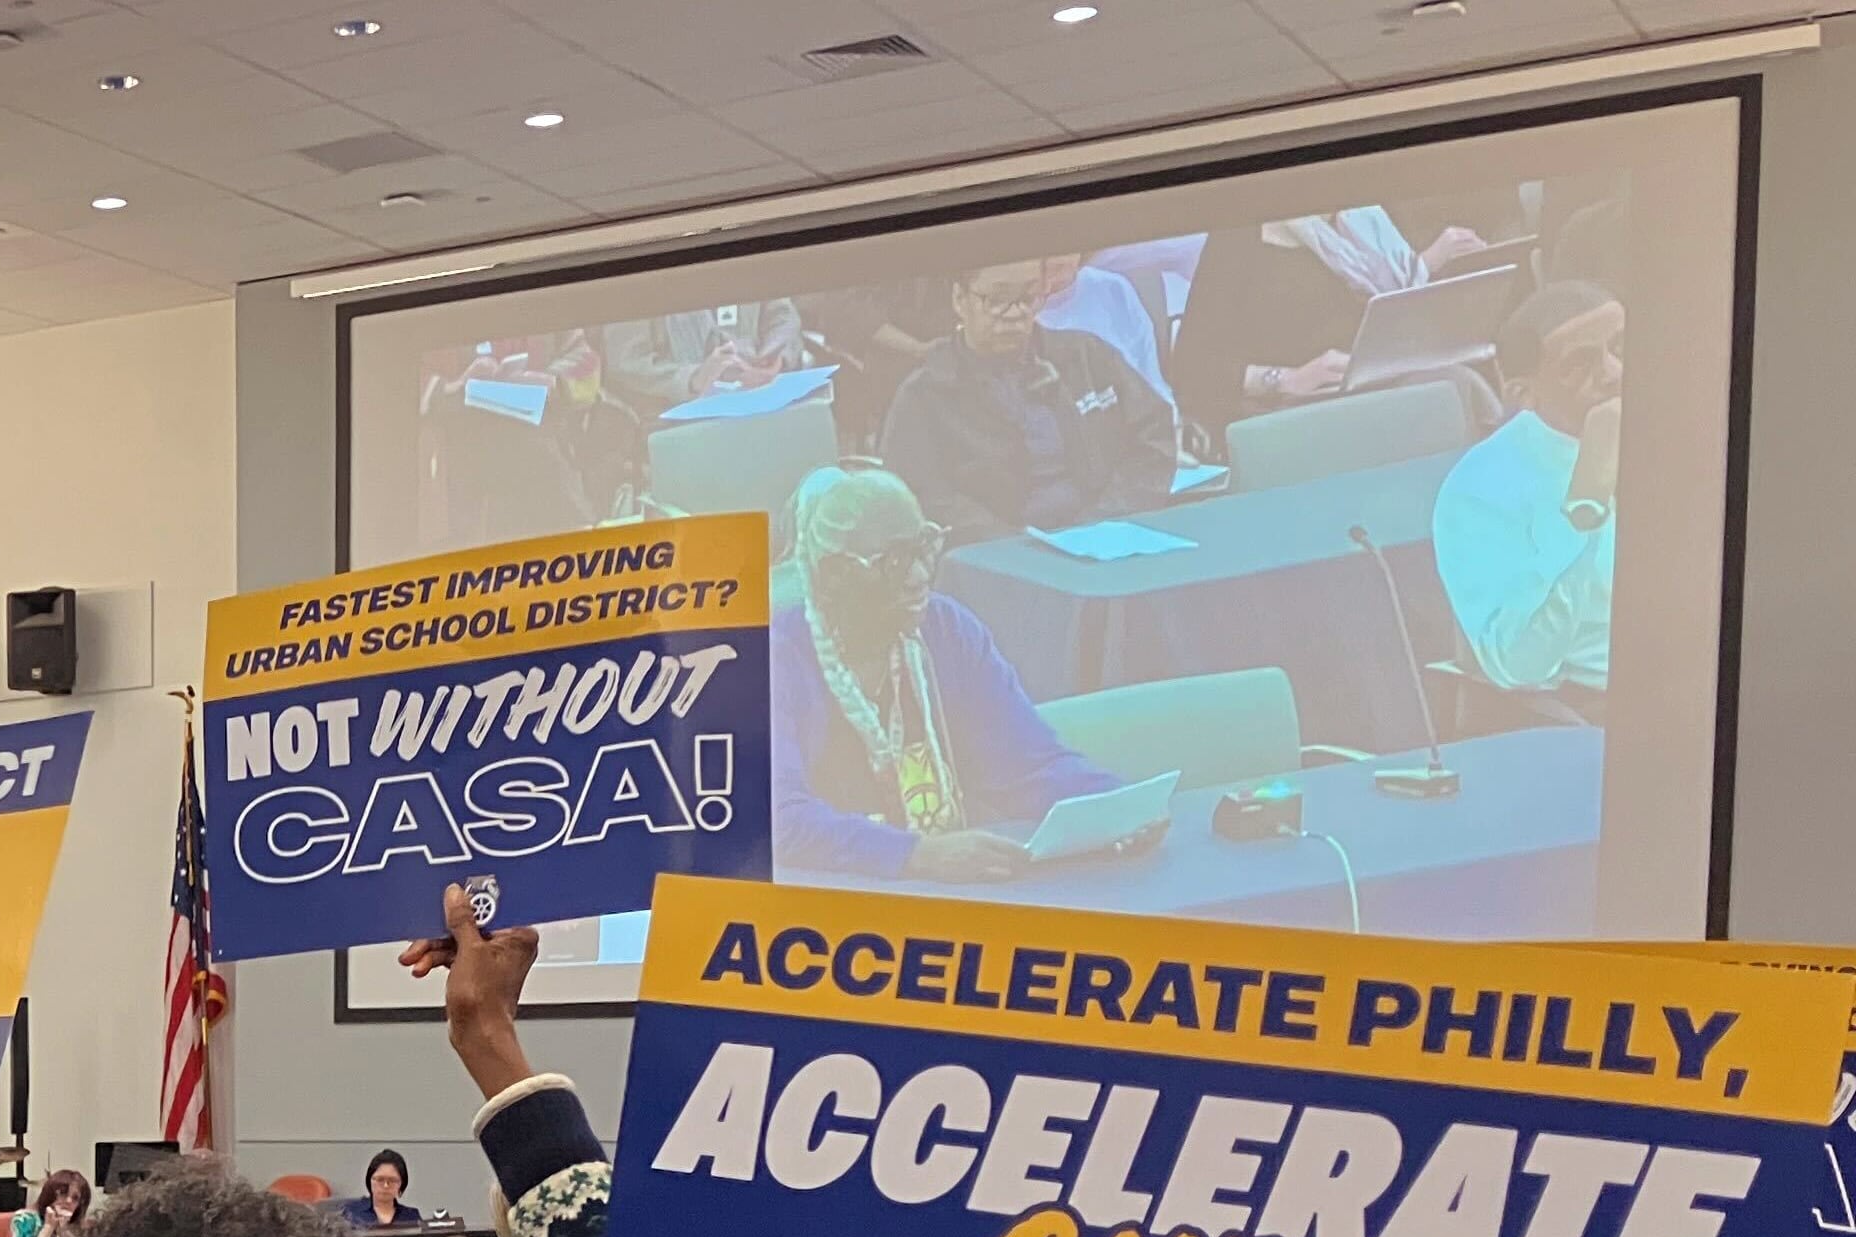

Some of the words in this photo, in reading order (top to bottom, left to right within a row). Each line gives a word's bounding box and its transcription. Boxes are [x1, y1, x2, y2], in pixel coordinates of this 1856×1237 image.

[225, 633, 352, 679] URBAN
[359, 607, 516, 658] SCHOOL
[526, 579, 738, 633] DISTRICT?
[279, 576, 439, 630] FASTEST
[445, 541, 675, 598] IMPROVING
[226, 697, 359, 782] NOT
[369, 643, 737, 762] WITHOUT
[234, 733, 734, 885] CASA!
[700, 921, 1324, 1041] ACCELERATE
[1347, 978, 1749, 1099] PHILLY,
